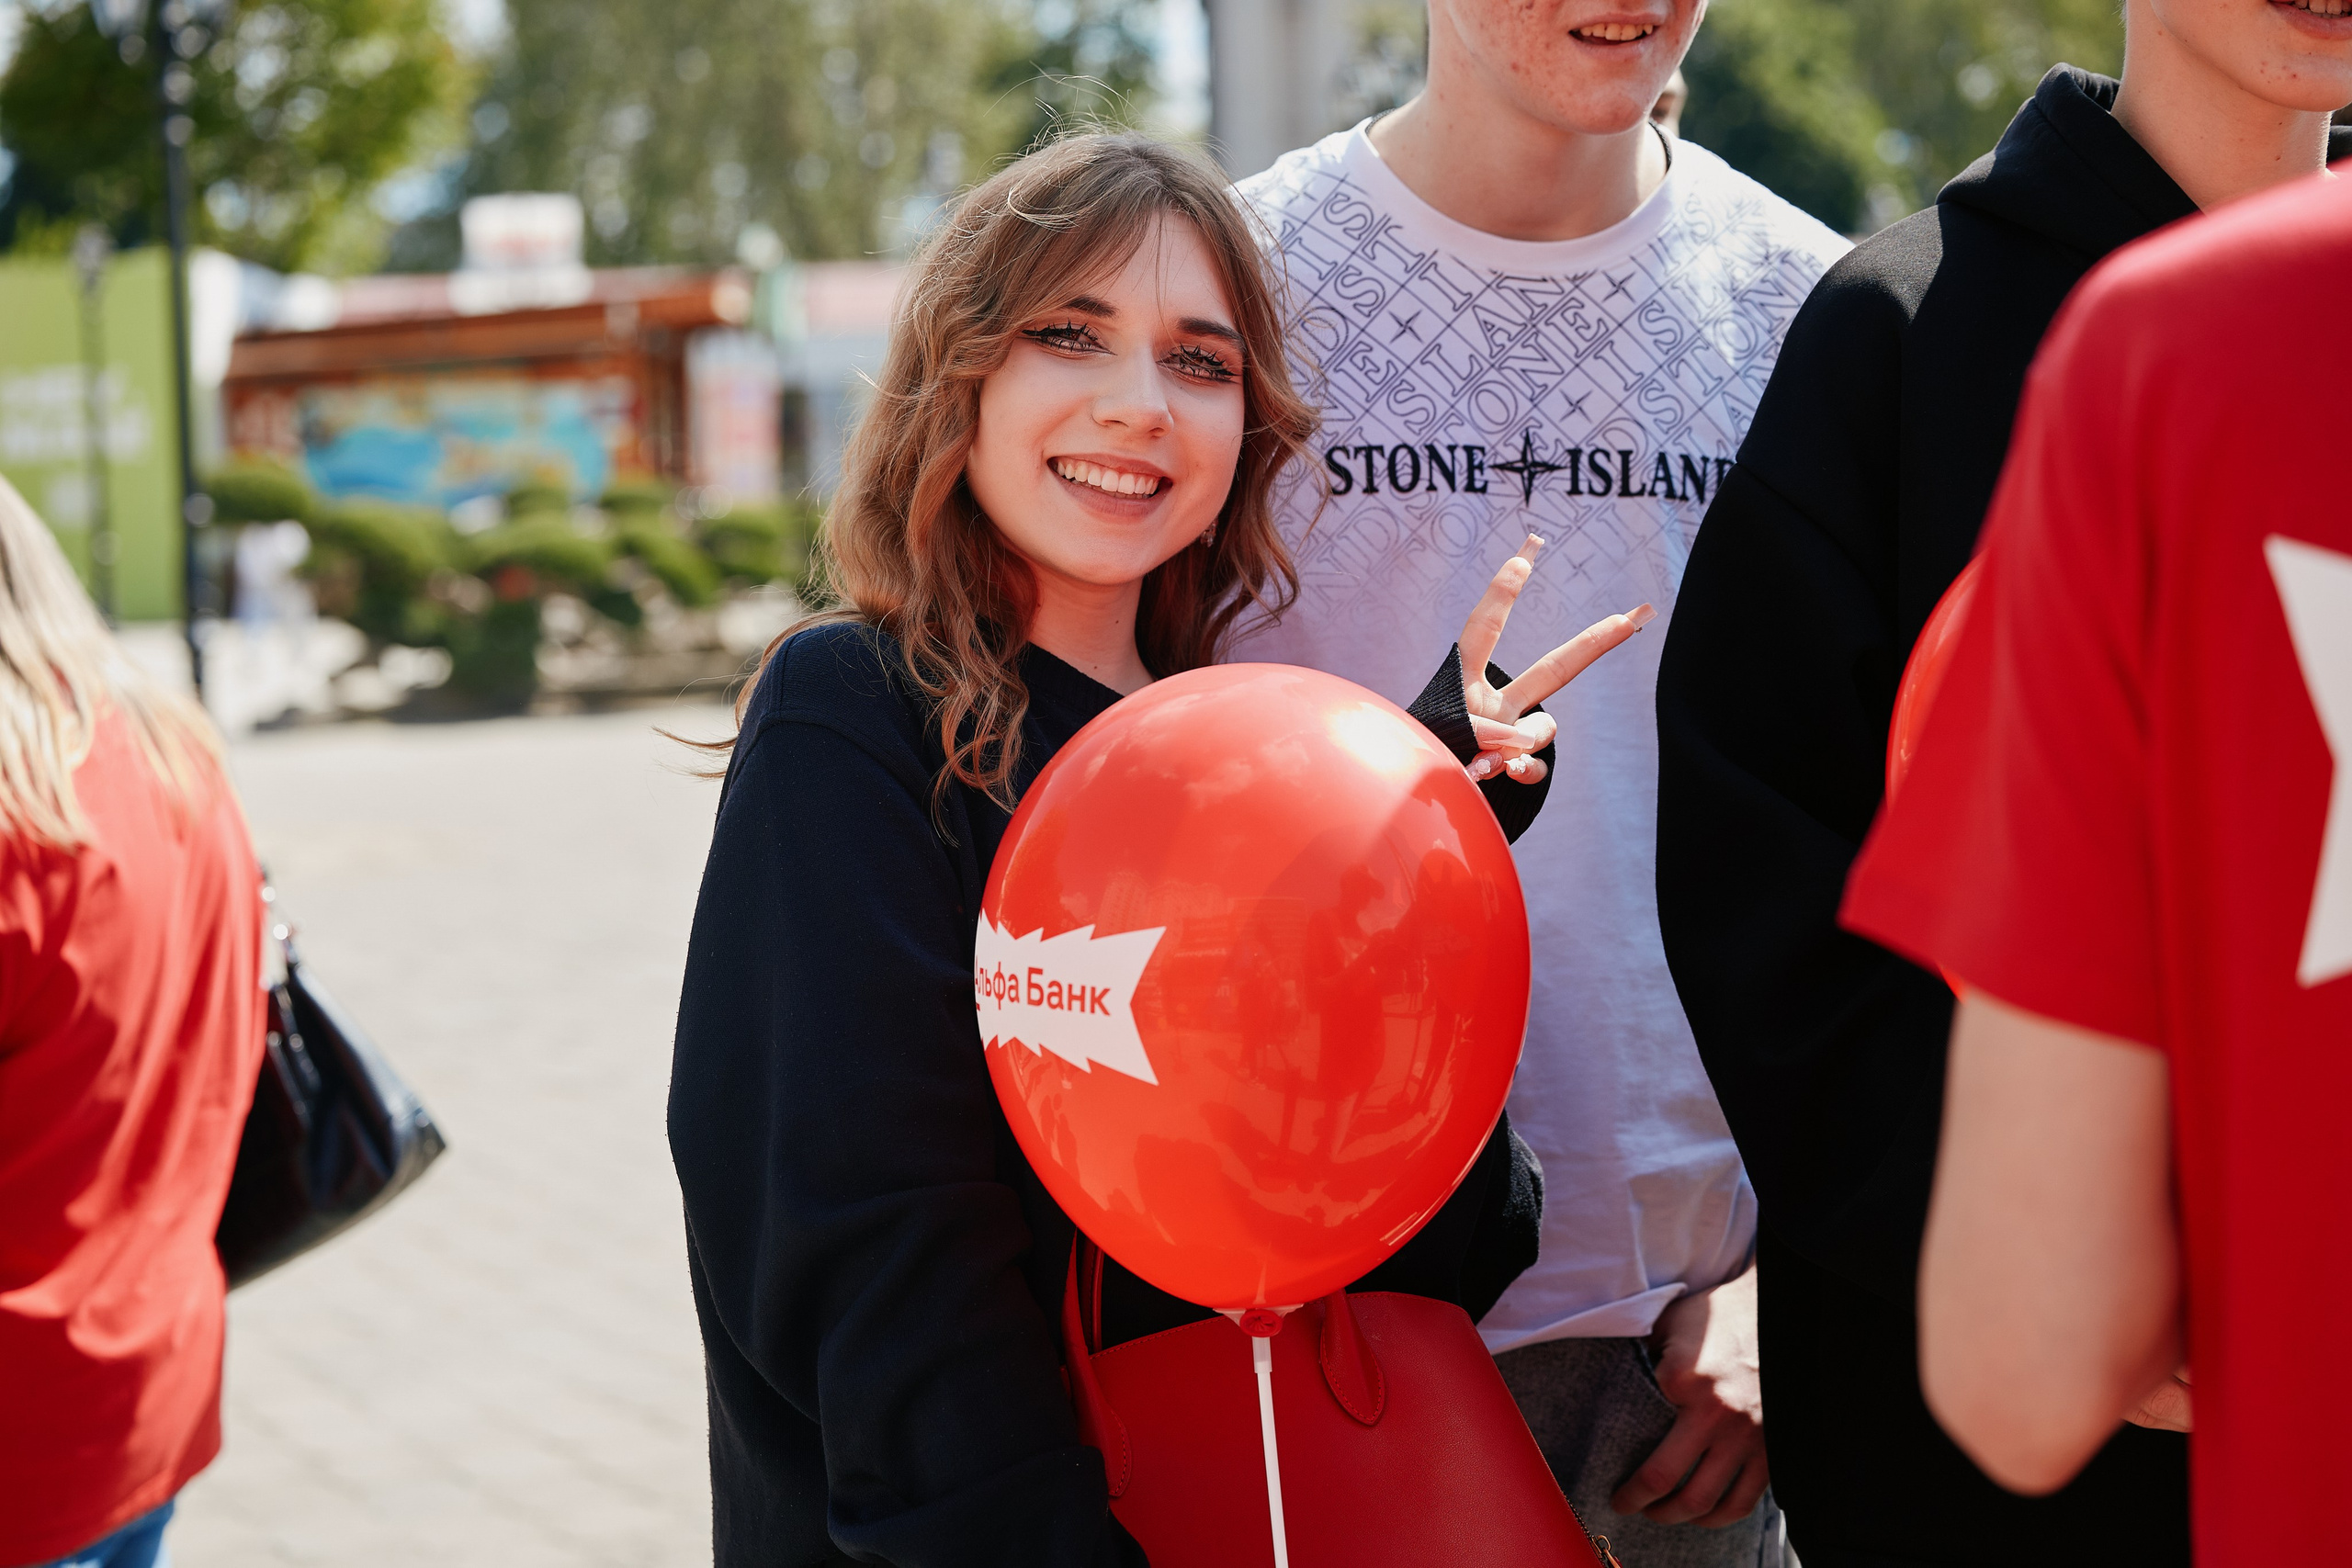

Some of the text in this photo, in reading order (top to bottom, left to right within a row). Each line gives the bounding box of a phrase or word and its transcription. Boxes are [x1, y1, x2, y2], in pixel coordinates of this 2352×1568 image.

[1325, 444, 1488, 496] STONE
[976, 955, 1111, 1017] льфа Банк
